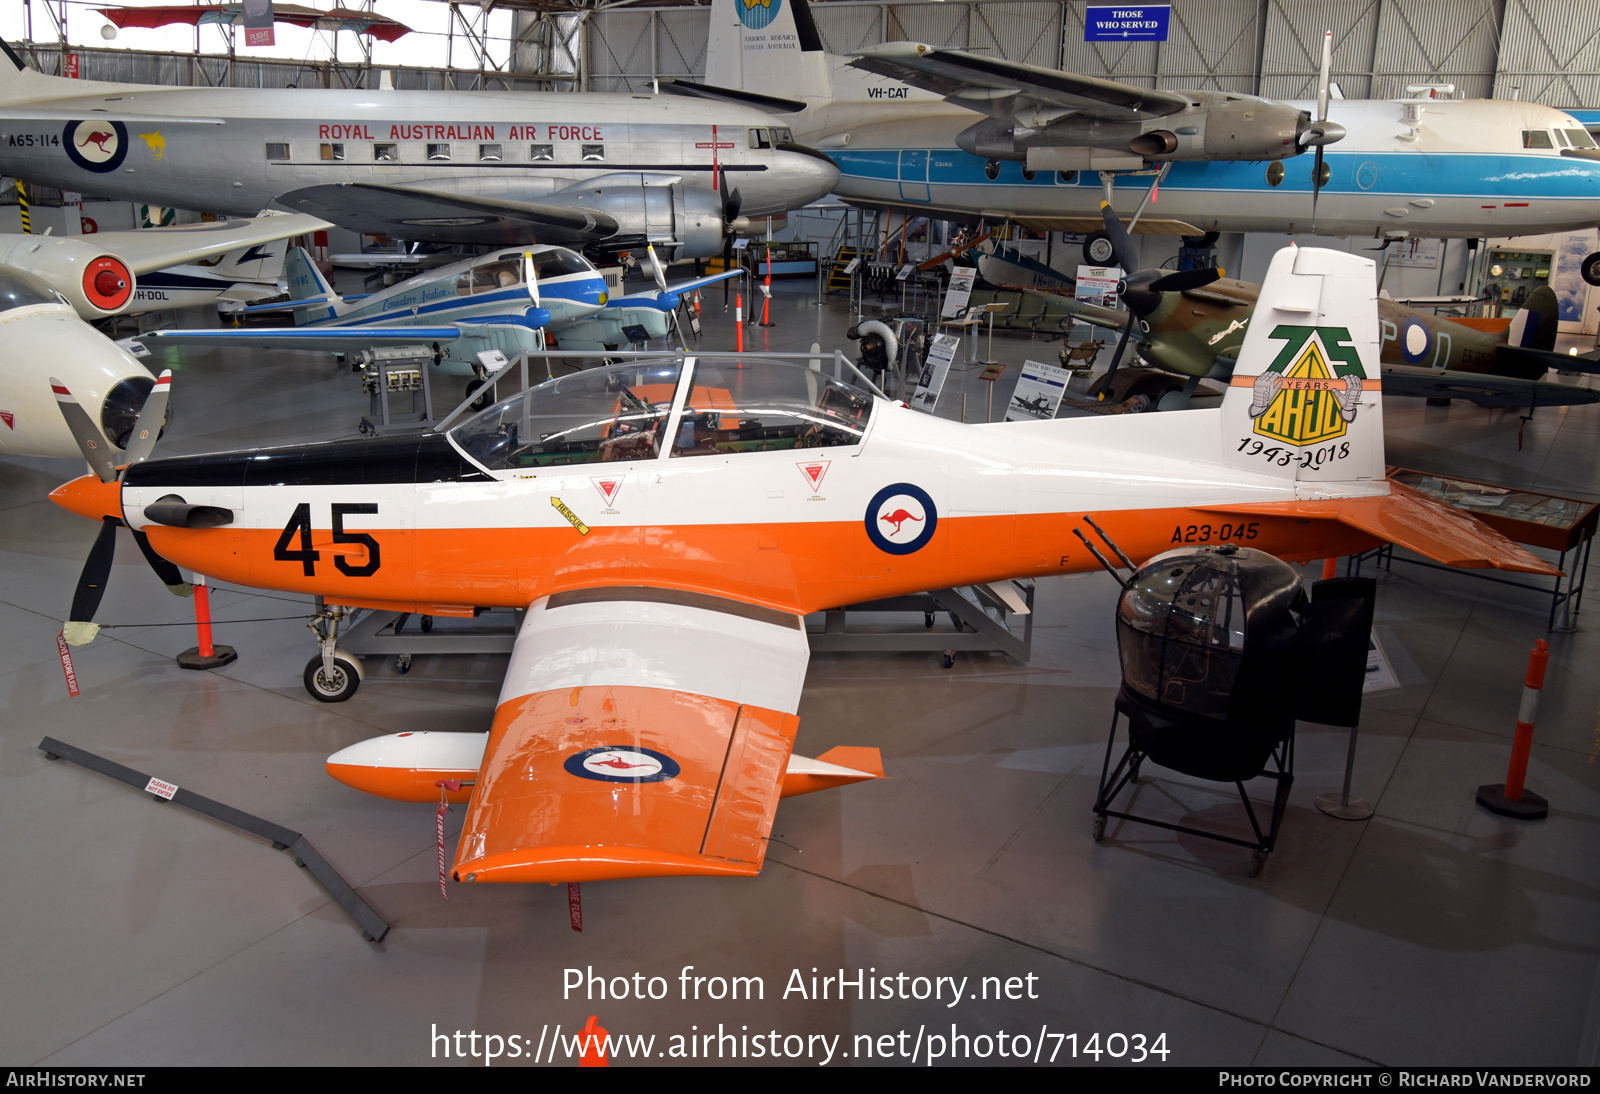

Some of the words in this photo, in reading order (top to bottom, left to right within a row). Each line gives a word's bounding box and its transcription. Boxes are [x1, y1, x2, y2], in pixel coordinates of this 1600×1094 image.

[1112, 10, 1144, 18] THOSE
[1096, 21, 1119, 29] WHO
[1120, 20, 1158, 29] SERVED
[867, 87, 909, 98] VH-CAT
[9, 134, 60, 147] A65-114
[318, 124, 375, 140] ROYAL
[389, 124, 496, 141] AUSTRALIAN
[508, 125, 537, 141] AIR
[548, 125, 605, 142] FORCE
[1268, 325, 1367, 379] 75
[1025, 361, 1039, 369] THOSE
[1052, 367, 1070, 377] SERVED
[1287, 381, 1329, 389] YEARS
[1237, 437, 1350, 471] 1943-2018
[557, 503, 583, 530] RESCUE
[273, 503, 381, 577] 45
[1171, 523, 1260, 543] A23-045
[62, 654, 74, 675] BEFORE
[67, 675, 78, 693] FLIGHT
[151, 780, 168, 790] PLEASE
[157, 788, 172, 798] ENTER
[438, 846, 446, 875] BEFORE
[570, 903, 581, 928] FLIGHT
